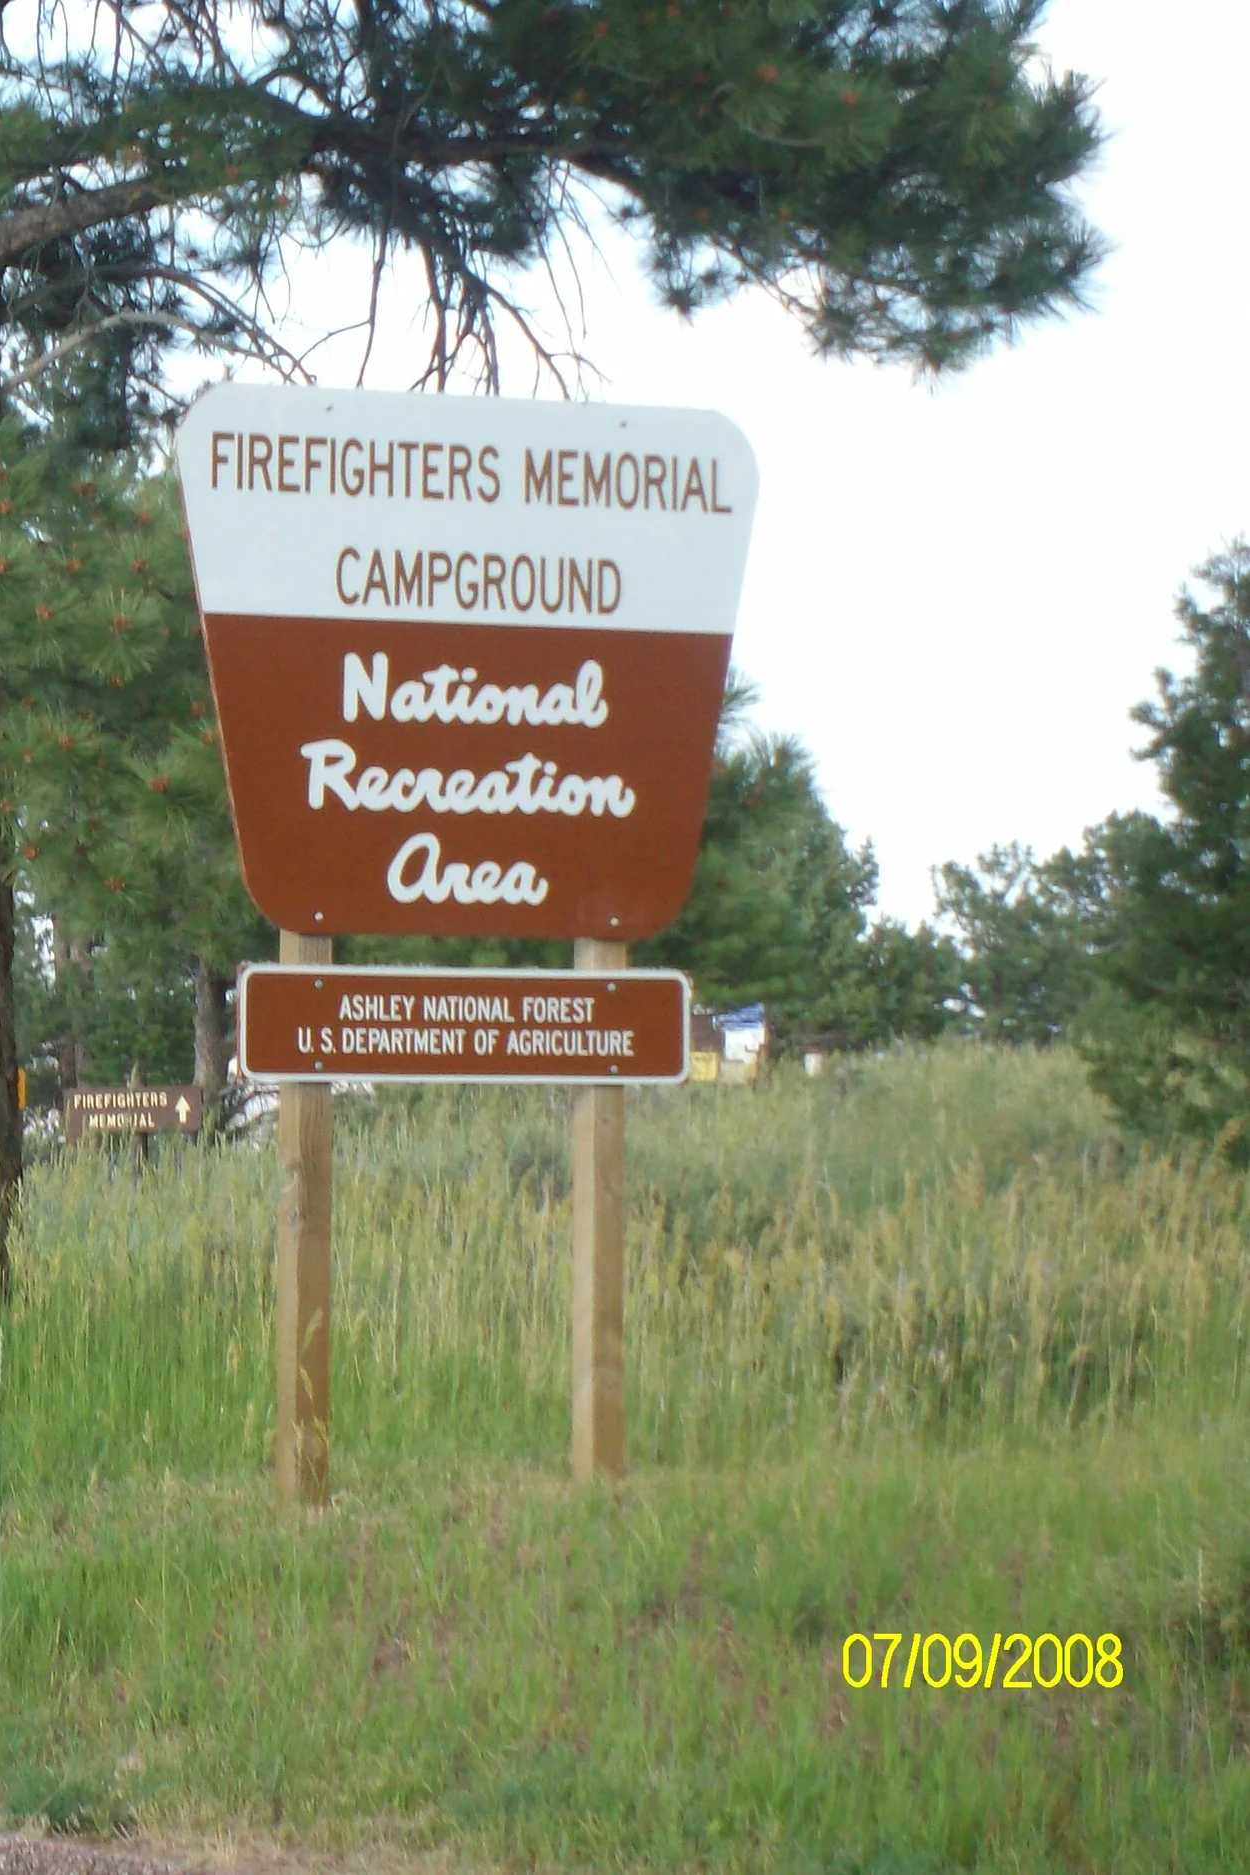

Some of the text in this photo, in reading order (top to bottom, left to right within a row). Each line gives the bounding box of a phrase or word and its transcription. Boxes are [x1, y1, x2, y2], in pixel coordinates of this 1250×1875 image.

[210, 430, 733, 515] FIREFIGHTERS MEMORIAL
[335, 545, 622, 615] CAMPGROUND
[342, 651, 609, 728] National
[300, 738, 636, 819] Recreation
[386, 832, 550, 905] Area
[338, 993, 596, 1024] ASHLEY NATIONAL FOREST
[341, 1027, 467, 1056] DEPARTMENT
[473, 1029, 499, 1057] OF
[506, 1029, 635, 1058] AGRICULTURE
[73, 1091, 168, 1110] FIREFIGHTERS
[89, 1112, 155, 1128] MMOIAL
